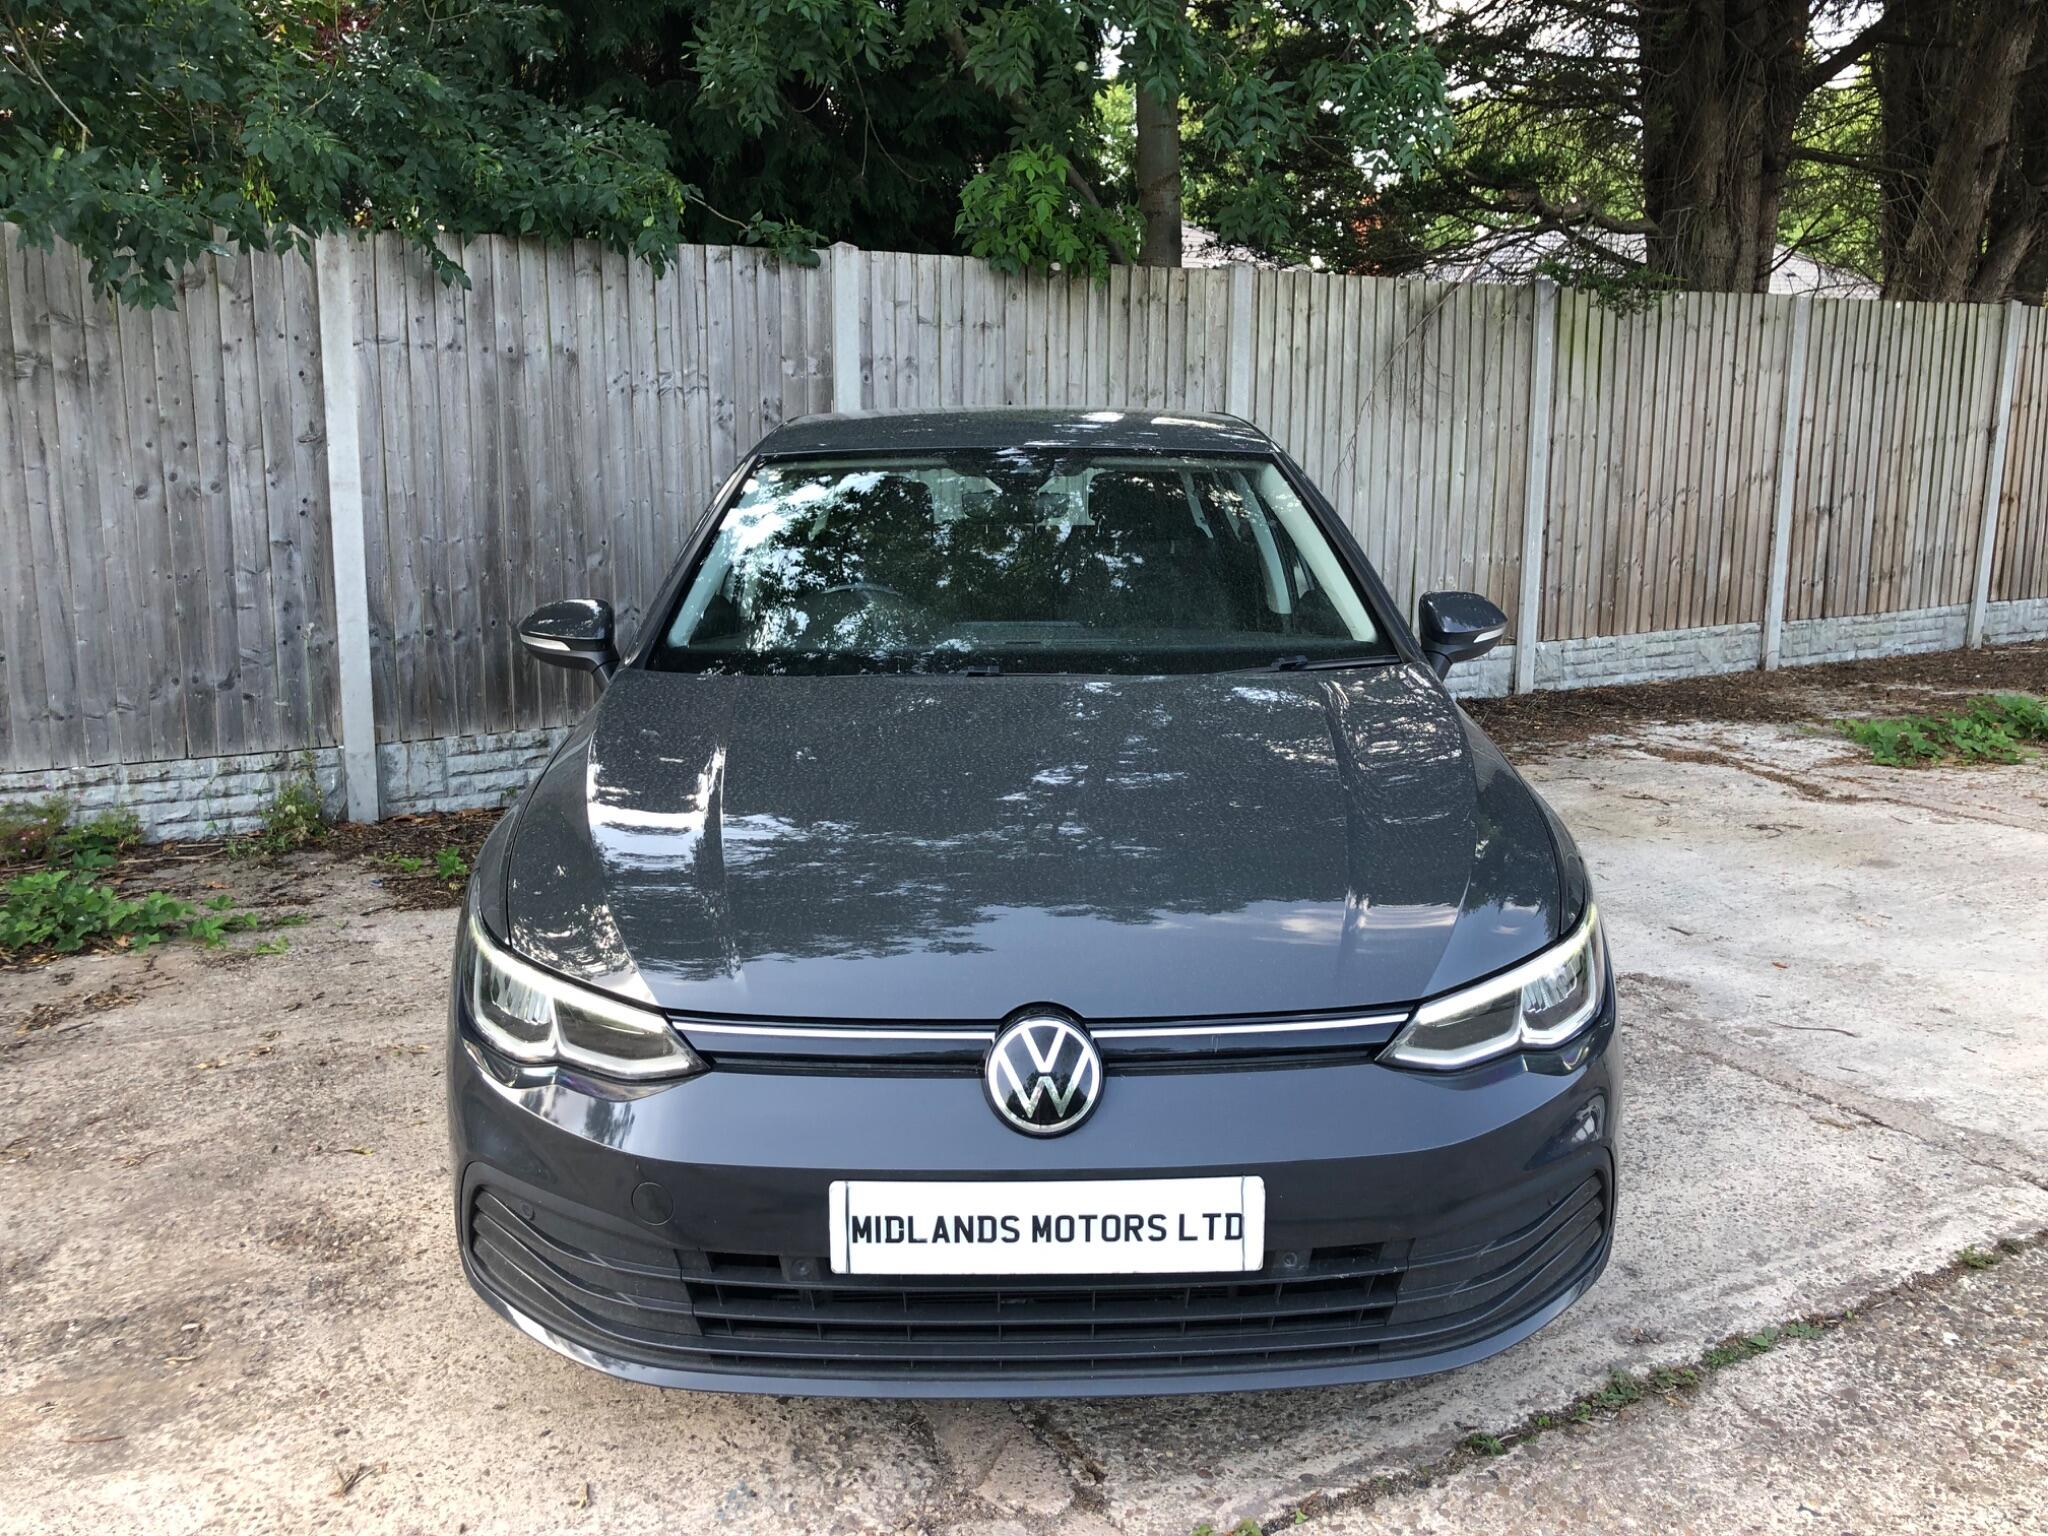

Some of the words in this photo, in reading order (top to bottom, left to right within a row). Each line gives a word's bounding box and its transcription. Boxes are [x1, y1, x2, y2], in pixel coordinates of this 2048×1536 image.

[993, 1022, 1095, 1121] VW
[851, 1214, 1021, 1244] MIDLANDS
[1031, 1213, 1167, 1243] MOTORS
[1178, 1212, 1244, 1241] LTD
